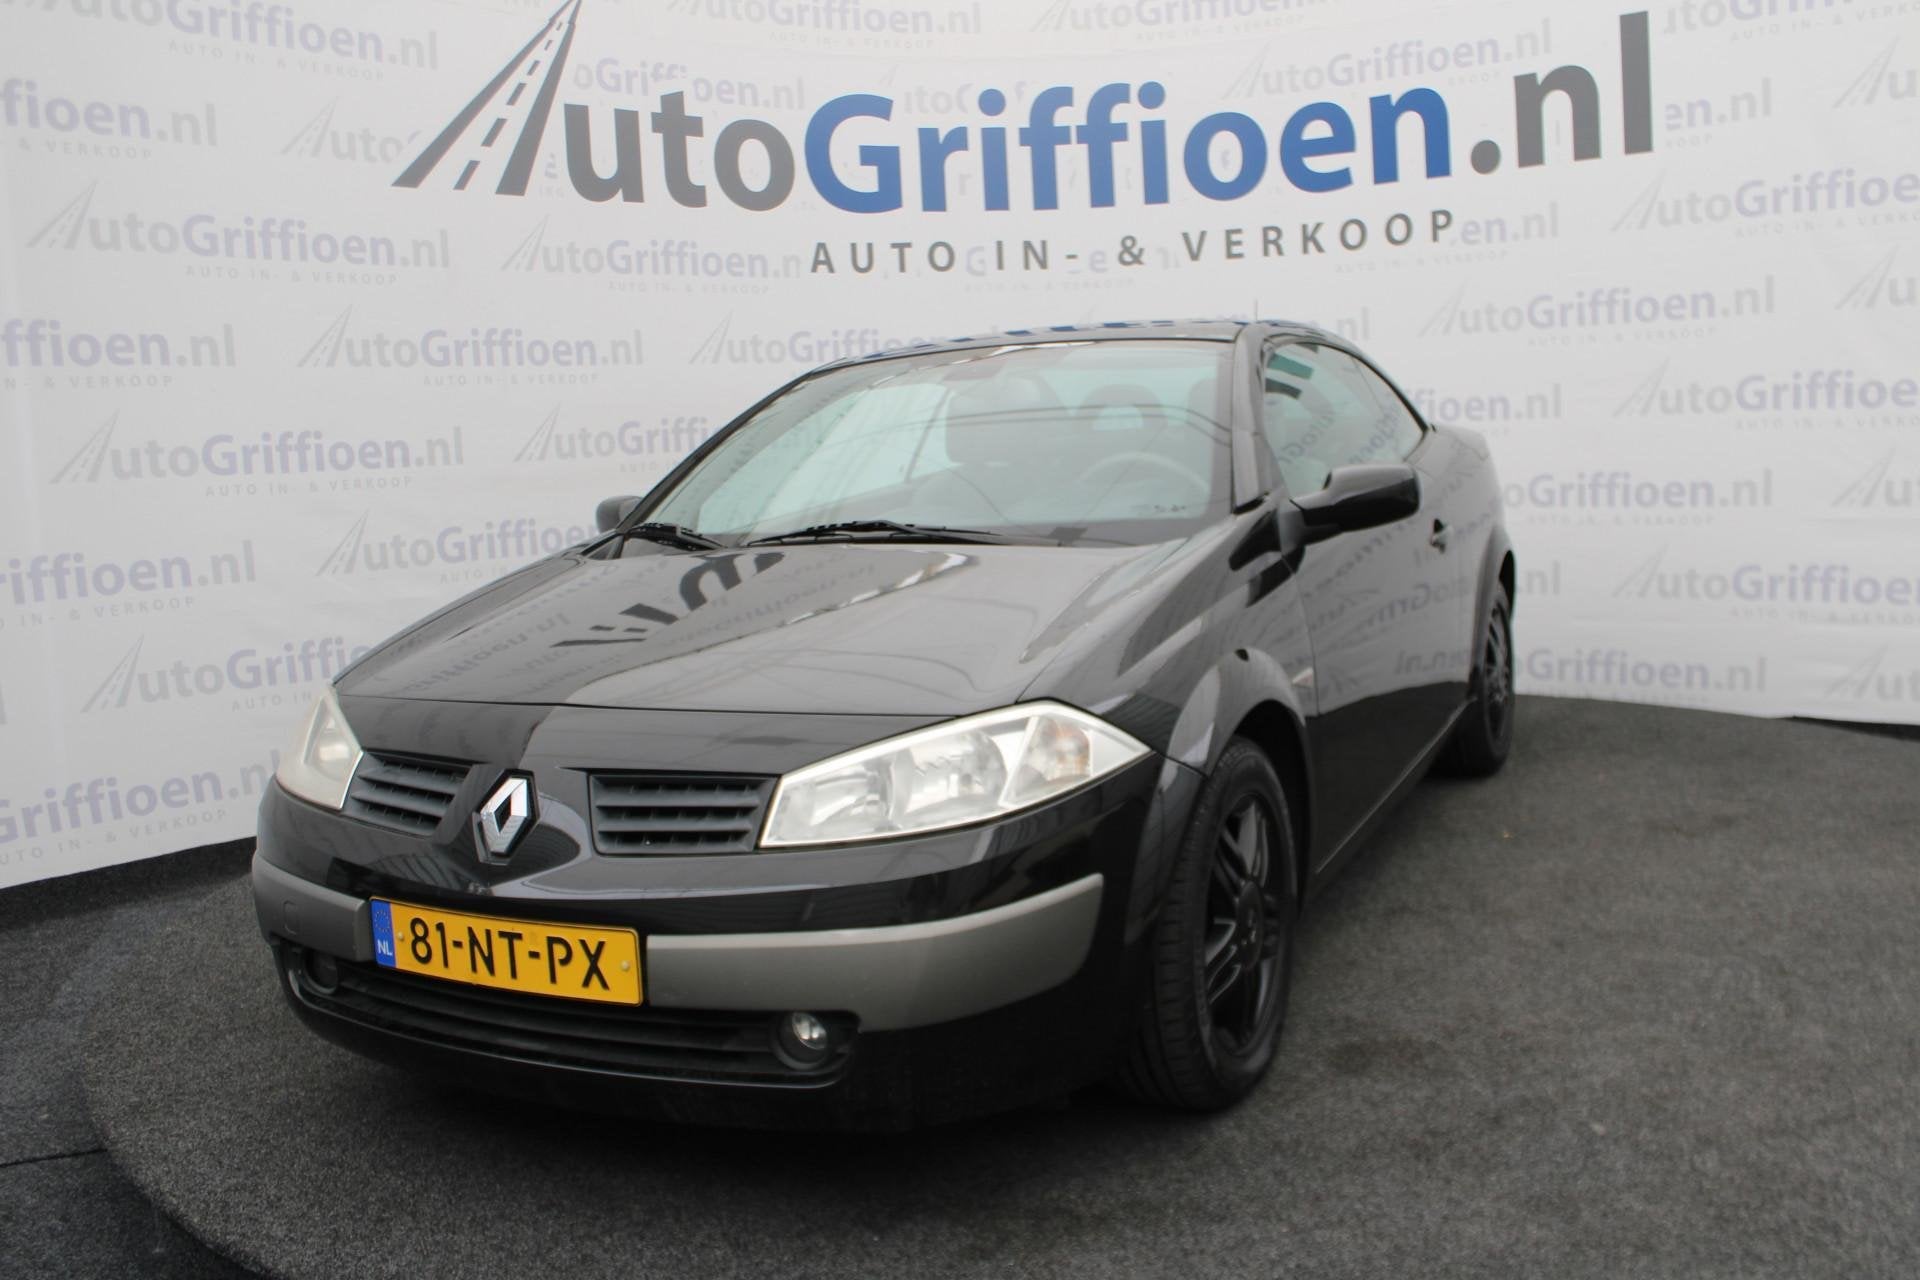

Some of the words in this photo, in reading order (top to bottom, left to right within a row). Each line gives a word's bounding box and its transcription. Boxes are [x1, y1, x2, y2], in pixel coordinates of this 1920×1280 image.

[809, 241, 956, 273] AUTO
[1117, 235, 1147, 267] &
[1180, 208, 1454, 263] VERKOOP
[377, 939, 393, 957] NL
[410, 917, 610, 990] 81-NT-PX
